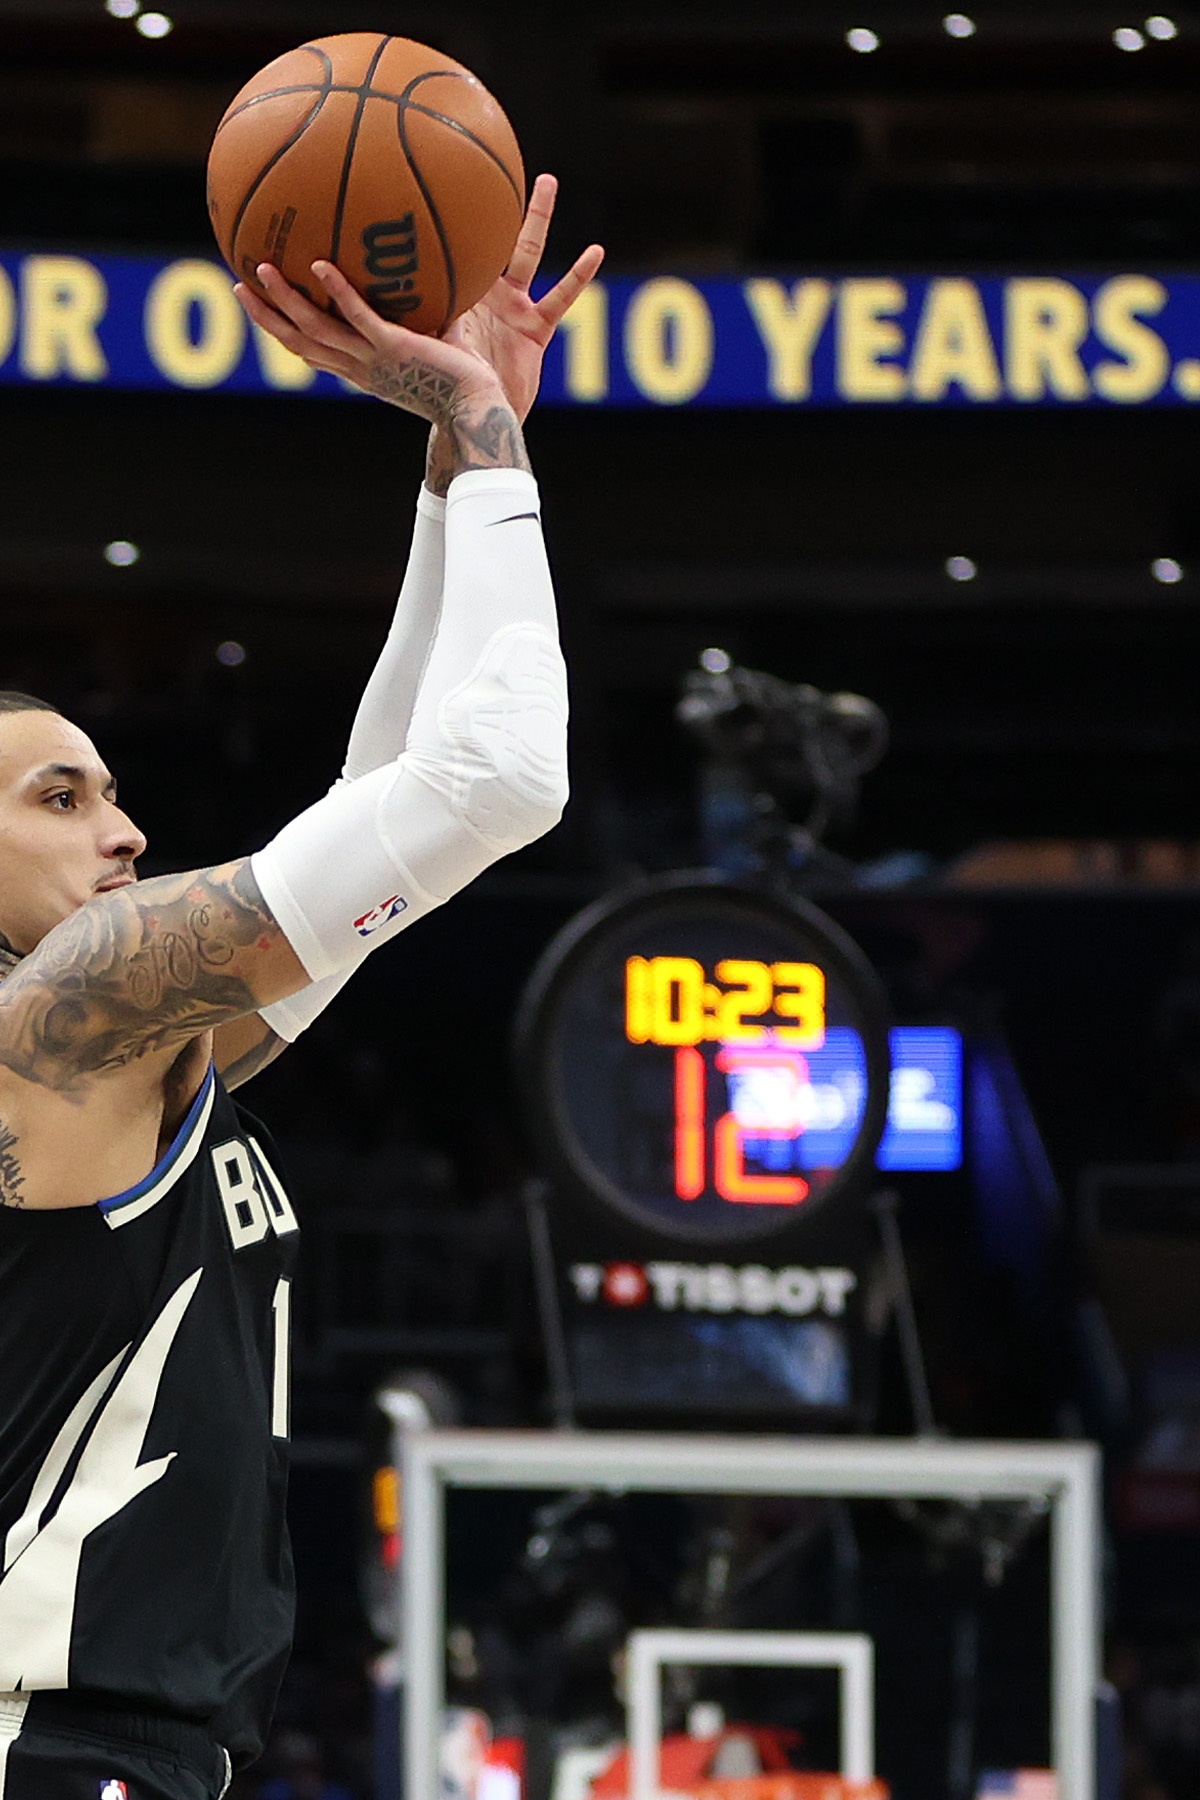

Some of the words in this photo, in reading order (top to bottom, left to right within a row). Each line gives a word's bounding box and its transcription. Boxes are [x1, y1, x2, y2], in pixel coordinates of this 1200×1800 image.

[555, 274, 715, 404] 10
[745, 272, 1200, 404] YEARS.
[625, 955, 827, 1051] 10:23
[674, 1044, 810, 1205] 12
[648, 1260, 856, 1317] TISSOT
